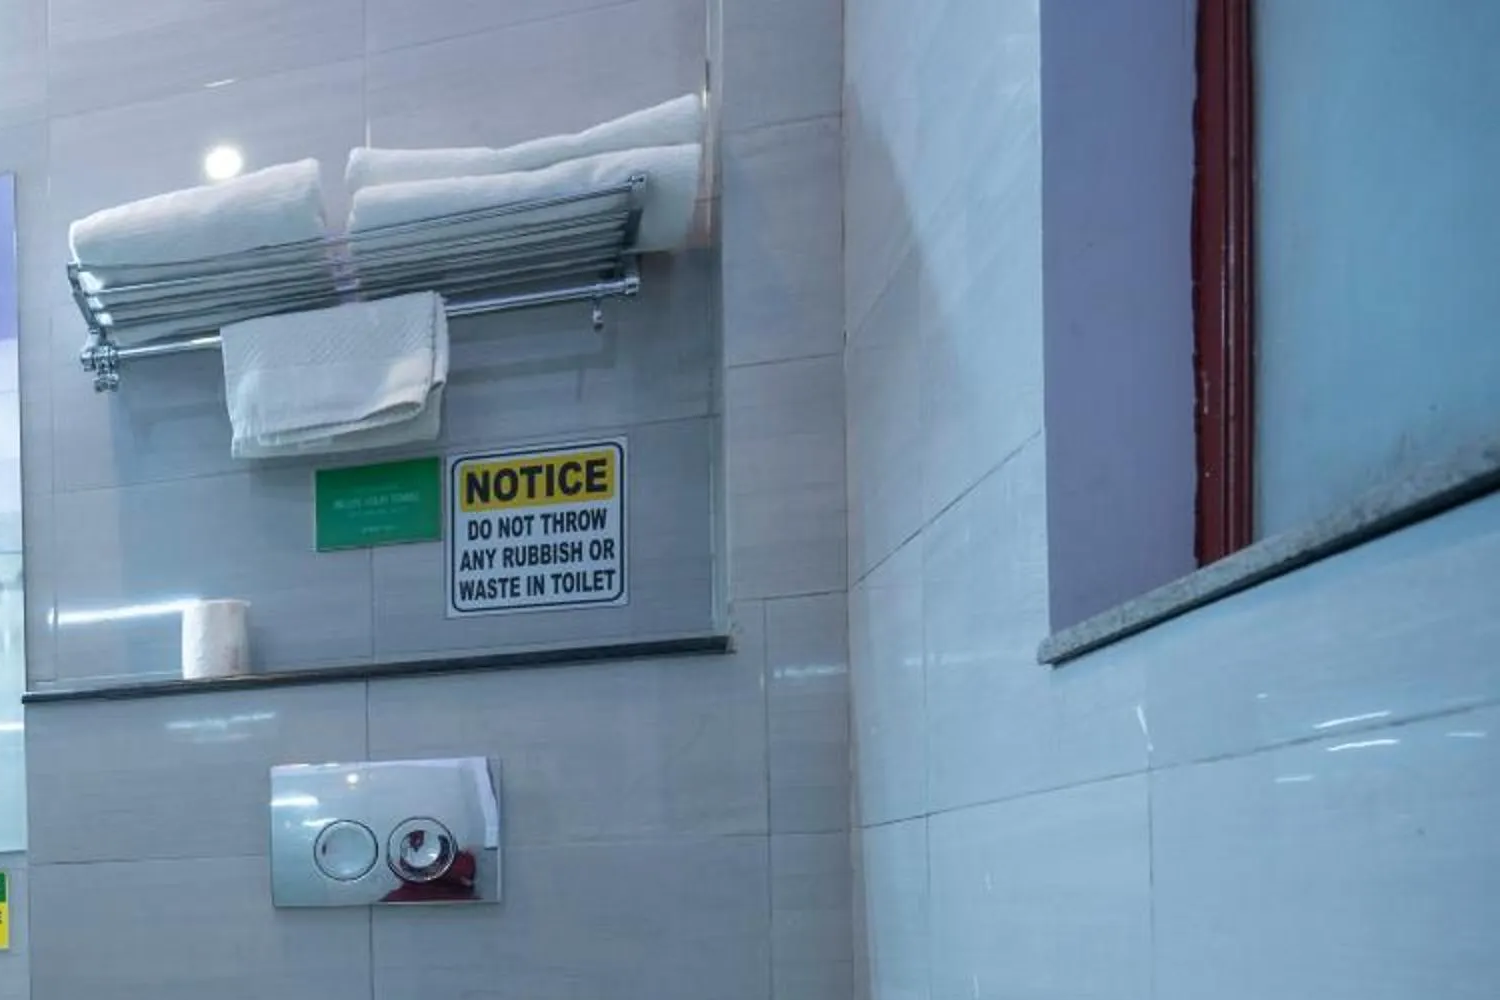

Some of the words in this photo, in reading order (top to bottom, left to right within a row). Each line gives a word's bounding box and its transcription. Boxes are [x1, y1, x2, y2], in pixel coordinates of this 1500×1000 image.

[466, 458, 607, 504] NOTICE
[467, 519, 492, 541] DO
[498, 514, 535, 538] NOT
[540, 507, 608, 536] THROW
[459, 548, 497, 572] ANY
[502, 540, 583, 568] RUBBISH
[589, 538, 615, 562] OR
[459, 576, 521, 601] WASTE
[527, 573, 545, 597] IN
[550, 569, 616, 595] TOILET
